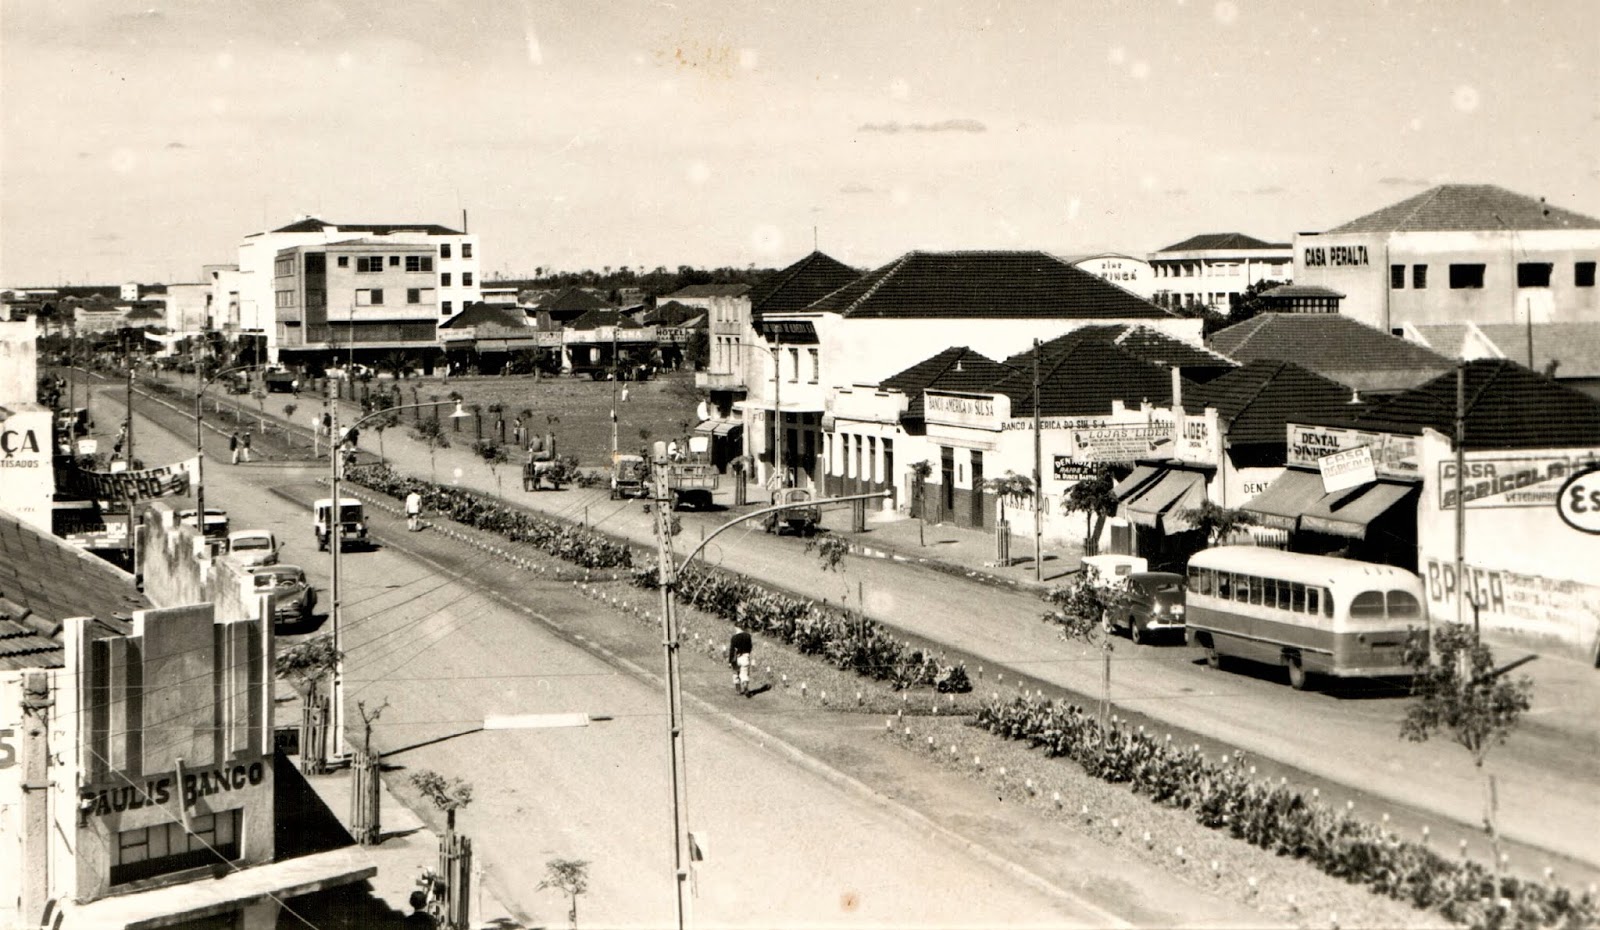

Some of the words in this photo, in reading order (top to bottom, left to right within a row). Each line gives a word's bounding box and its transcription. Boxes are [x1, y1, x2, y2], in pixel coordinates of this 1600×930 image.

[1305, 248, 1326, 266] CASA
[1330, 246, 1369, 266] PERALTA
[656, 328, 685, 336] HOTEL
[1002, 422, 1025, 430] BANCO
[1028, 420, 1062, 430] AERICA
[1183, 421, 1208, 440] LIDER
[1302, 433, 1340, 447] DENTAL
[1325, 449, 1364, 465] CASA
[79, 777, 170, 829] PAULIS
[182, 761, 264, 812] BANCO
